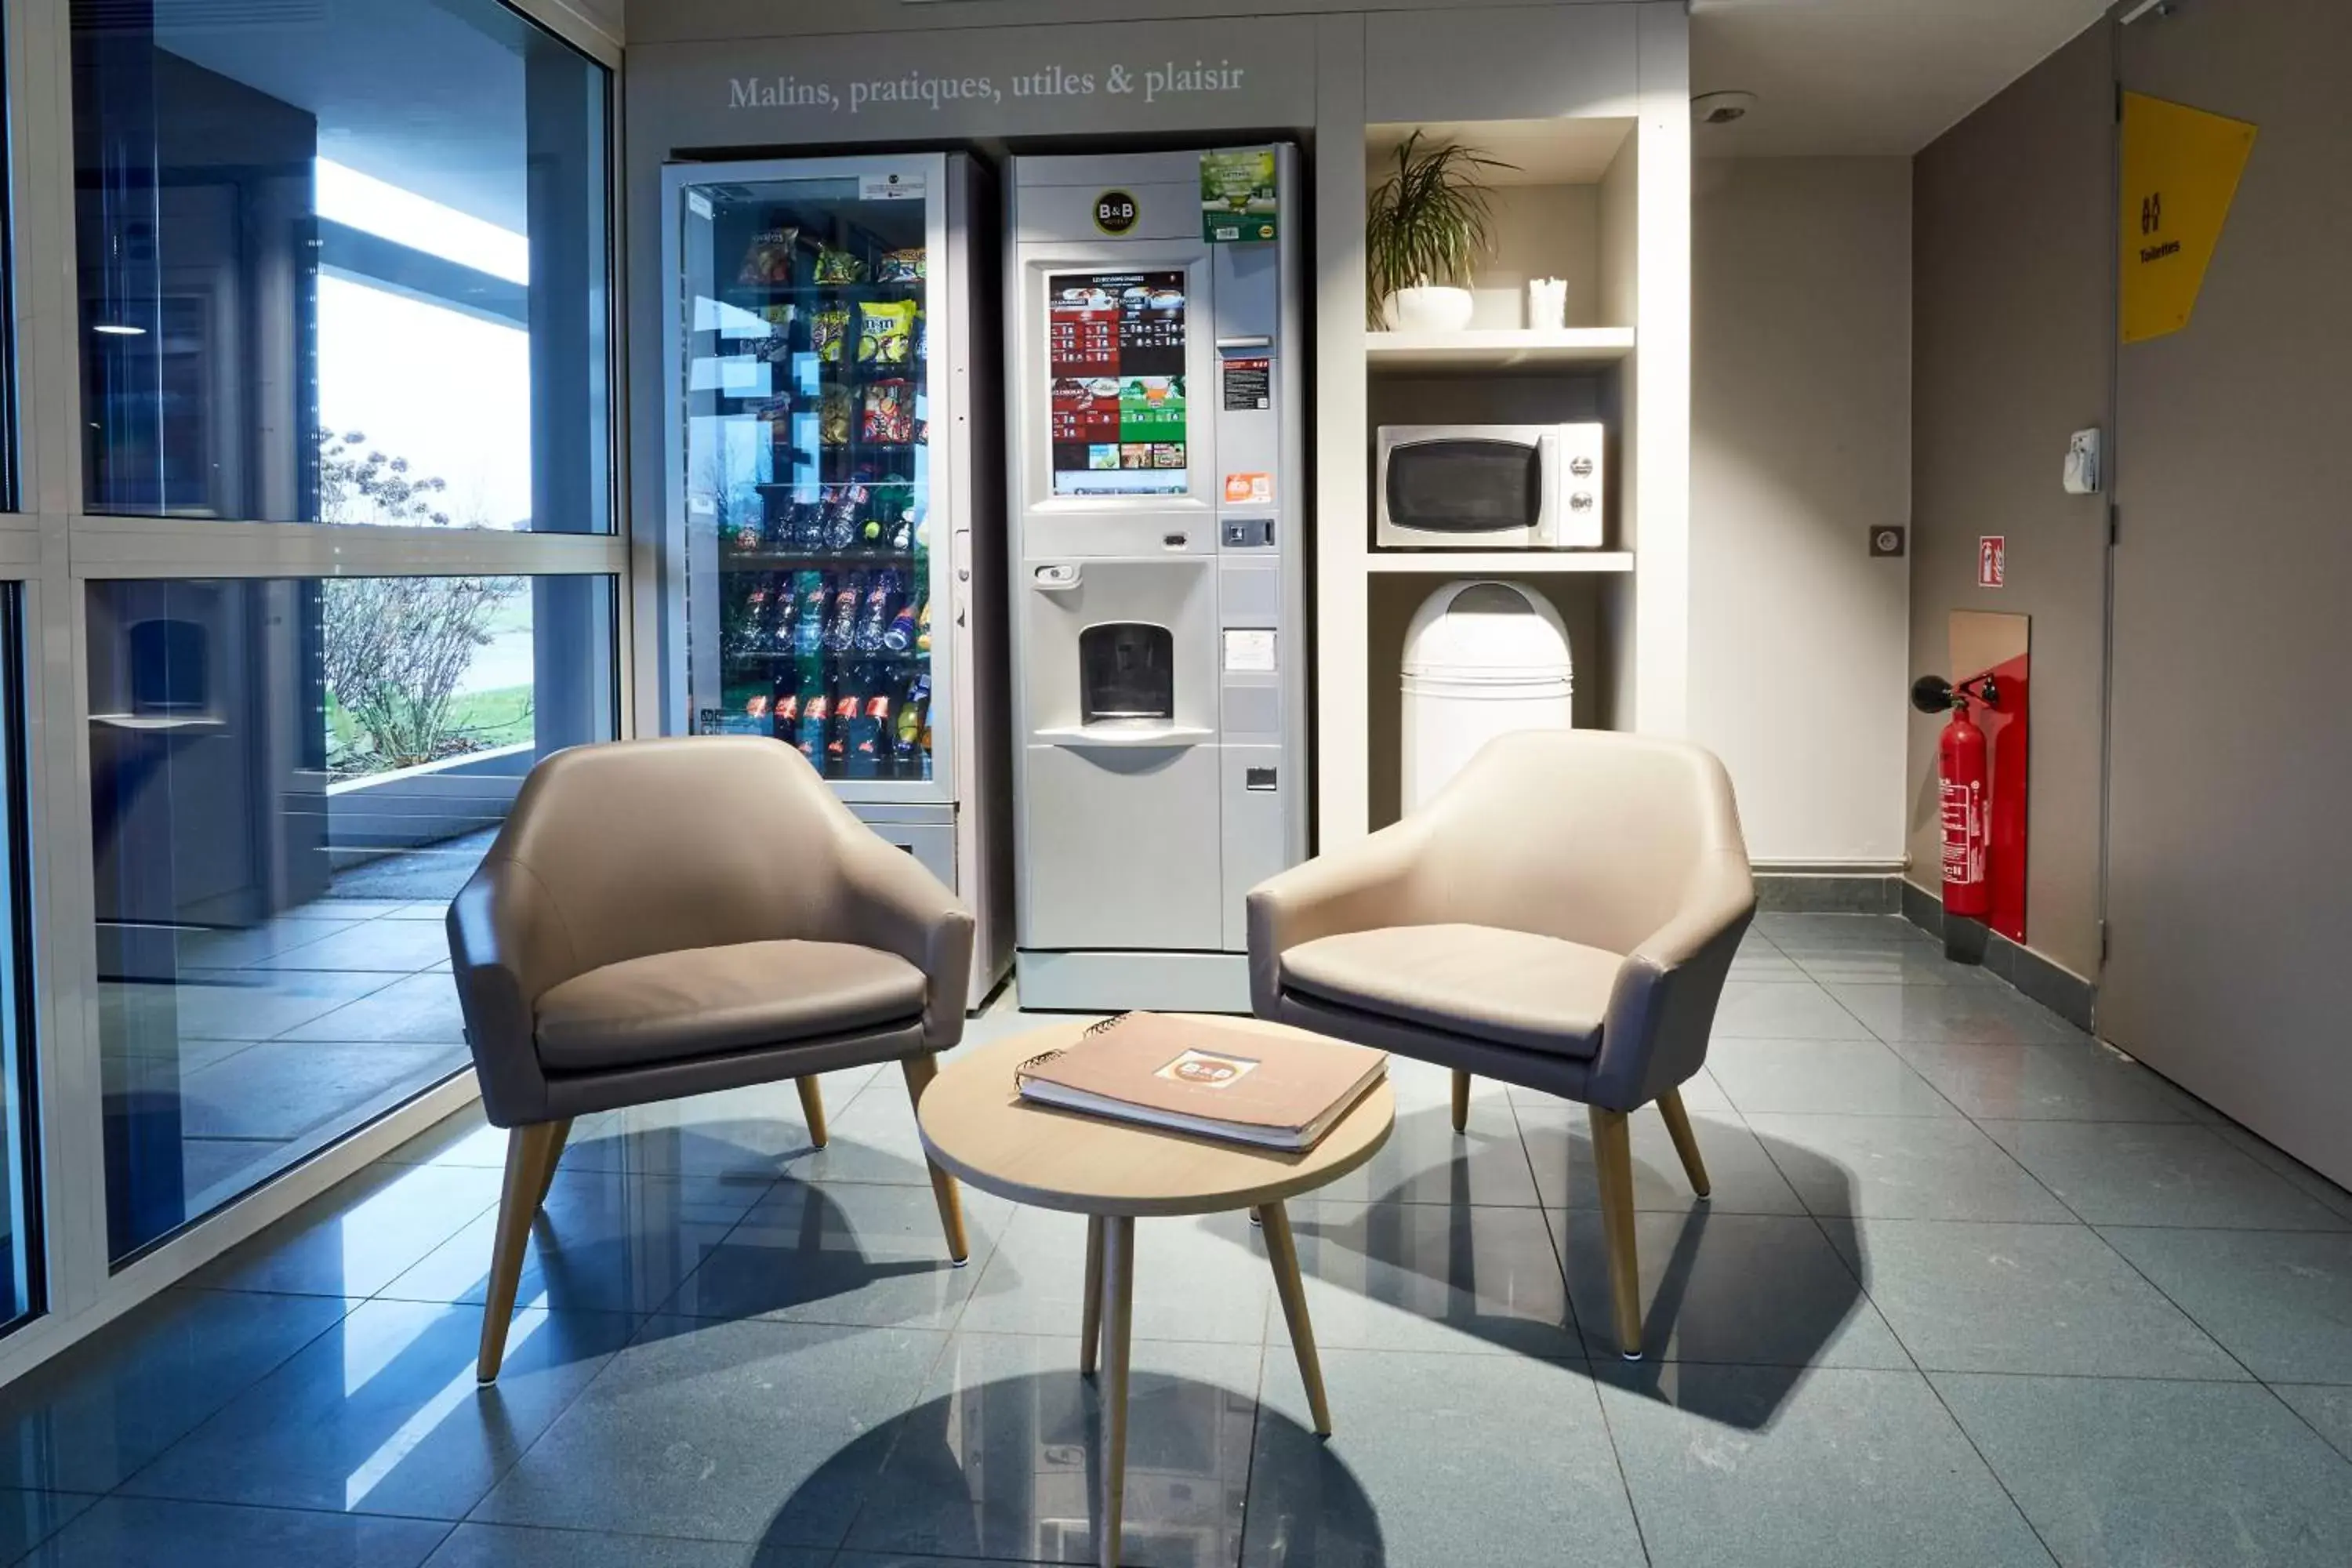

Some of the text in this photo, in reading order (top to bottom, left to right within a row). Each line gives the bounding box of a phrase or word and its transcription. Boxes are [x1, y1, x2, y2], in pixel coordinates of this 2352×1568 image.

[728, 59, 1244, 114] Malins, pratiques, utiles & plaisir
[2140, 240, 2180, 264] Toilettes
